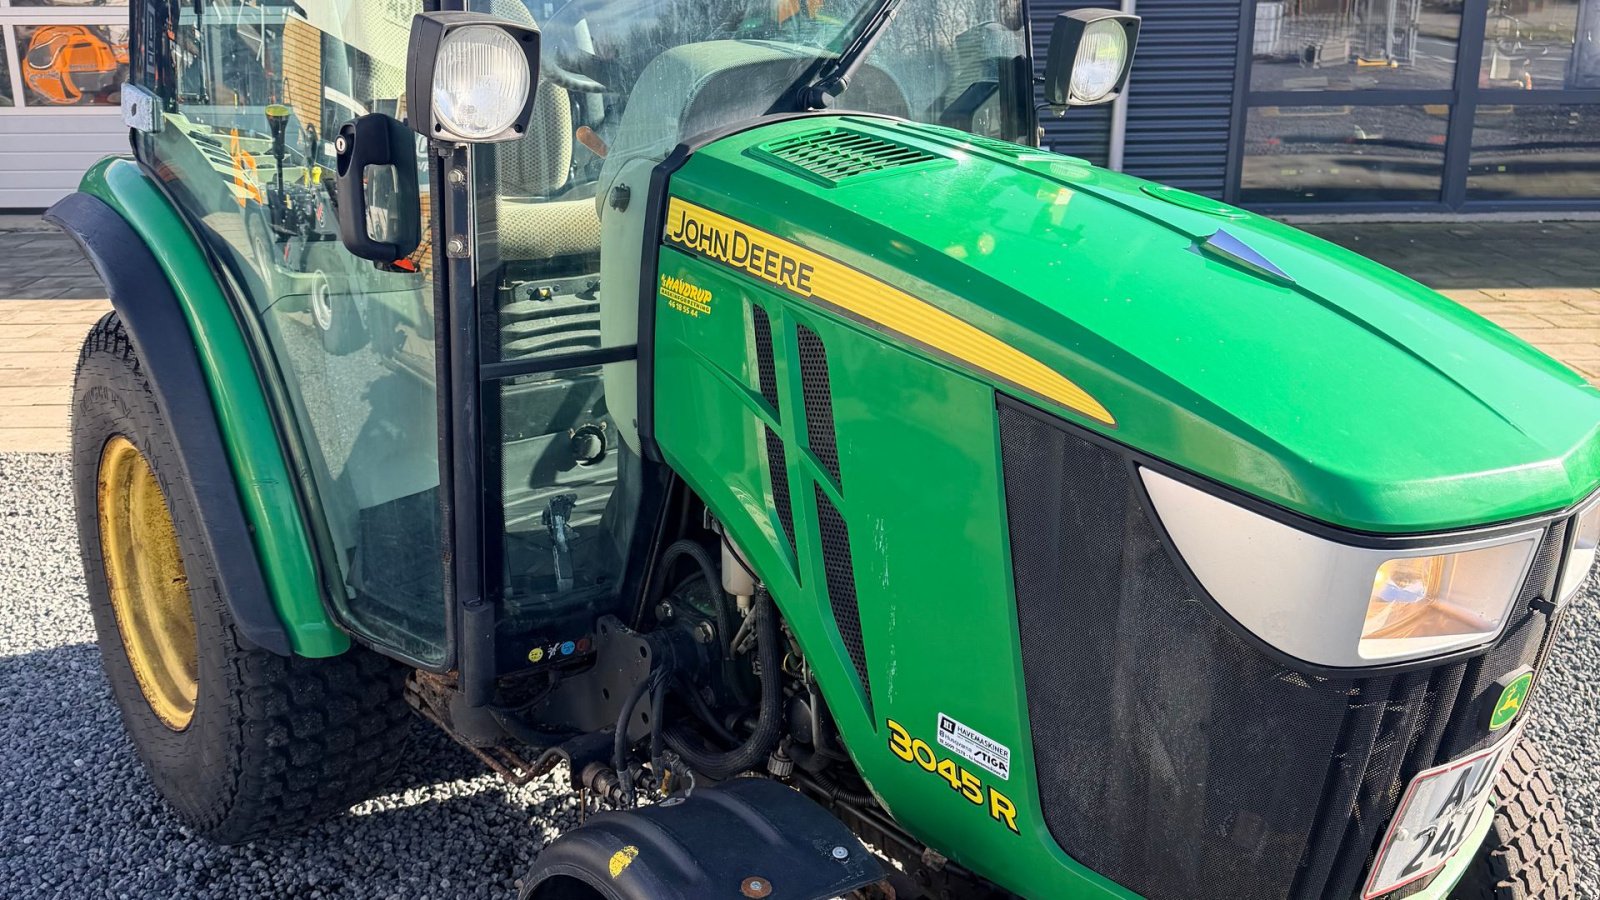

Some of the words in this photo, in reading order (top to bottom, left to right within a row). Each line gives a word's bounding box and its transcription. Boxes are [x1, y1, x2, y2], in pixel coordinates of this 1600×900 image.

[673, 210, 729, 259] JOHN
[731, 230, 815, 293] DEERE
[665, 275, 713, 304] HAVDRUP
[957, 725, 1009, 757] HAVEMASKINER
[886, 718, 984, 806] 3045
[987, 785, 1021, 836] R
[974, 750, 1008, 773] STIGA
